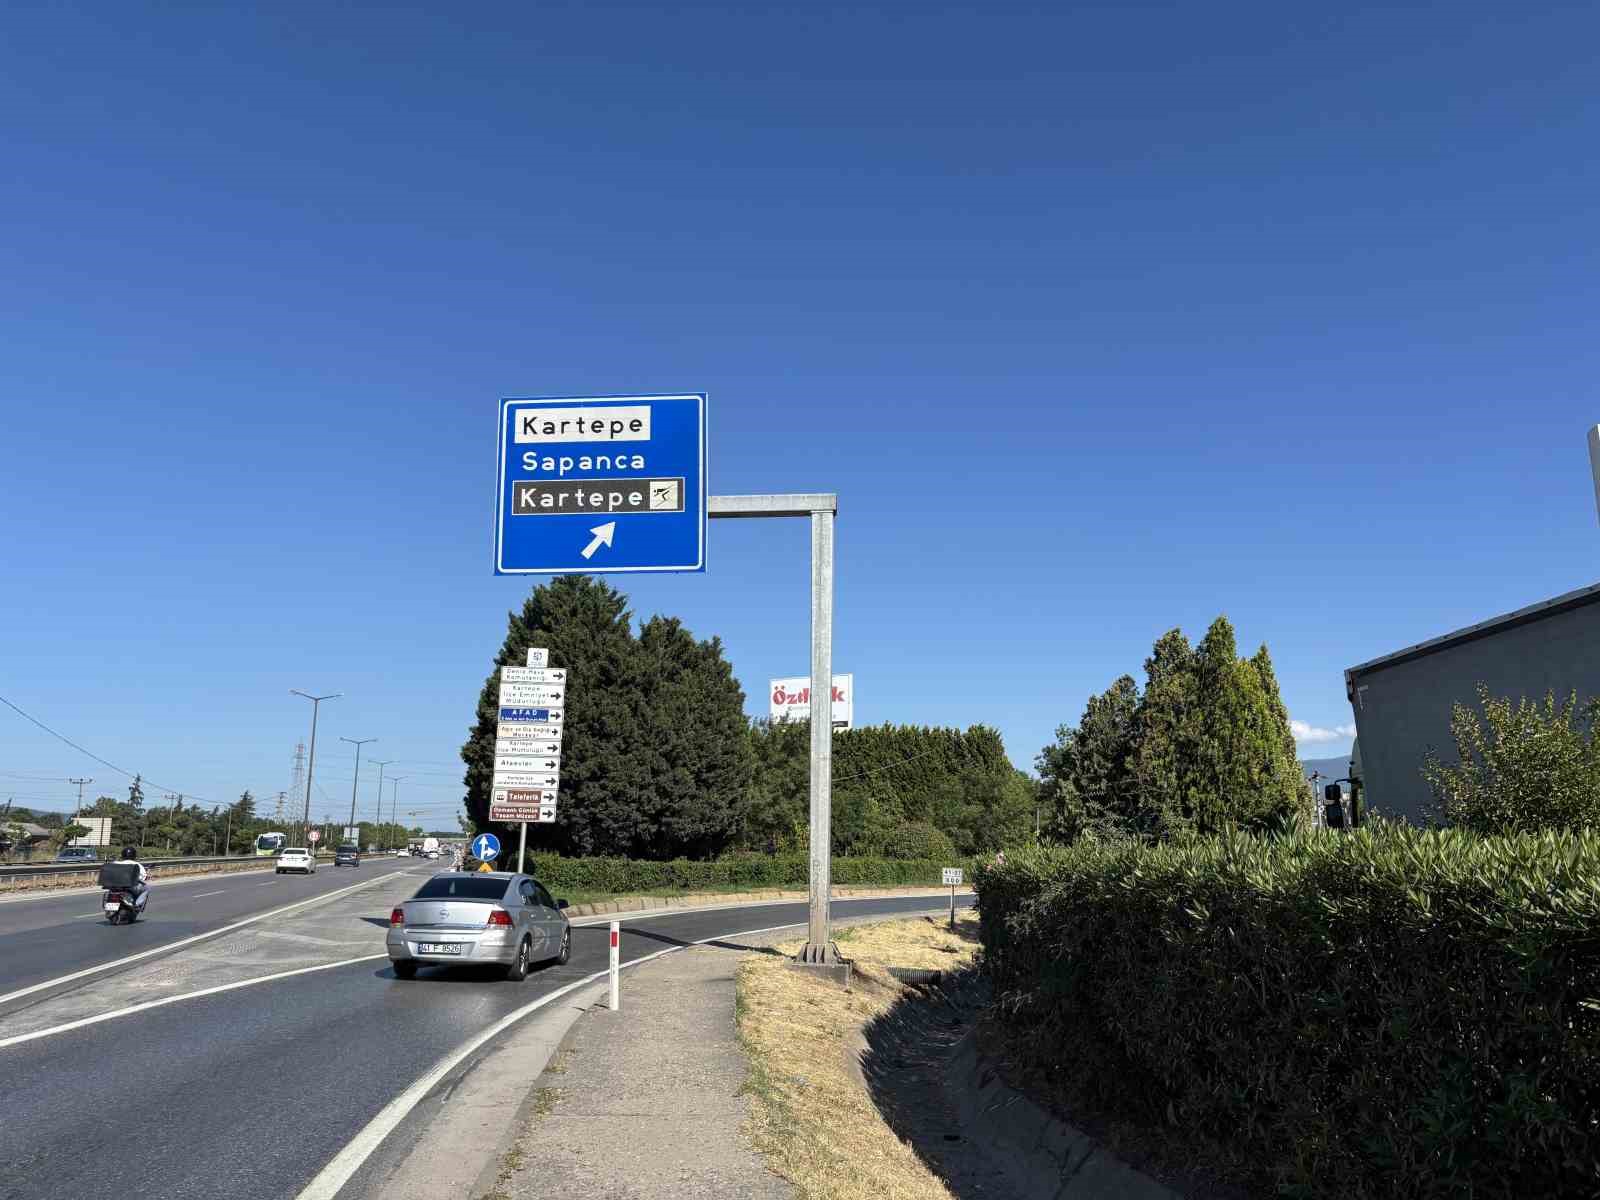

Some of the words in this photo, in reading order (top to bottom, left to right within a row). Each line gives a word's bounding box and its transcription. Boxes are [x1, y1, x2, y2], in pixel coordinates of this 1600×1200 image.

[523, 416, 643, 439] Kartepe
[522, 451, 646, 476] Sapanca
[520, 487, 643, 511] Kartepe
